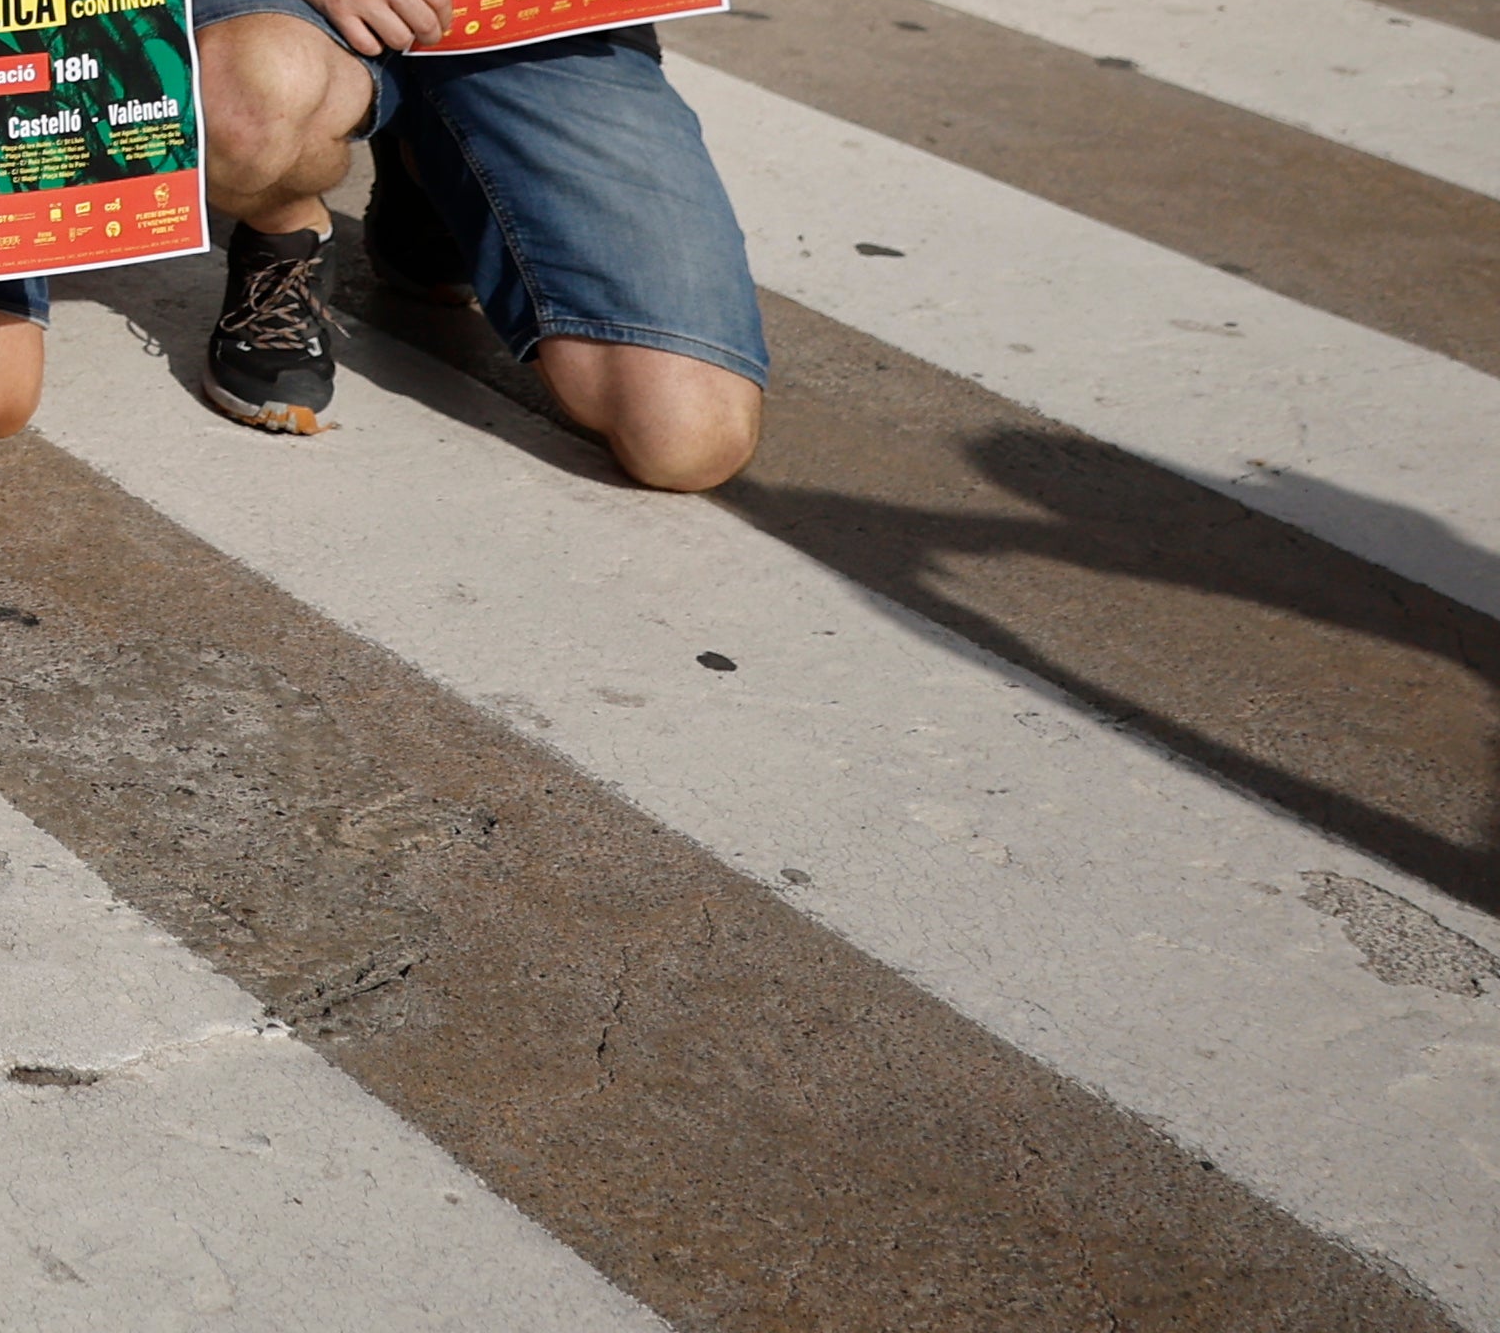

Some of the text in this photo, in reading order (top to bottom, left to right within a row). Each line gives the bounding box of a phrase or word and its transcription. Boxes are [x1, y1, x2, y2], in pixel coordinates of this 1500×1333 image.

[53, 53, 99, 85] 18h
[8, 108, 81, 140] Castelló
[107, 94, 179, 125] València
